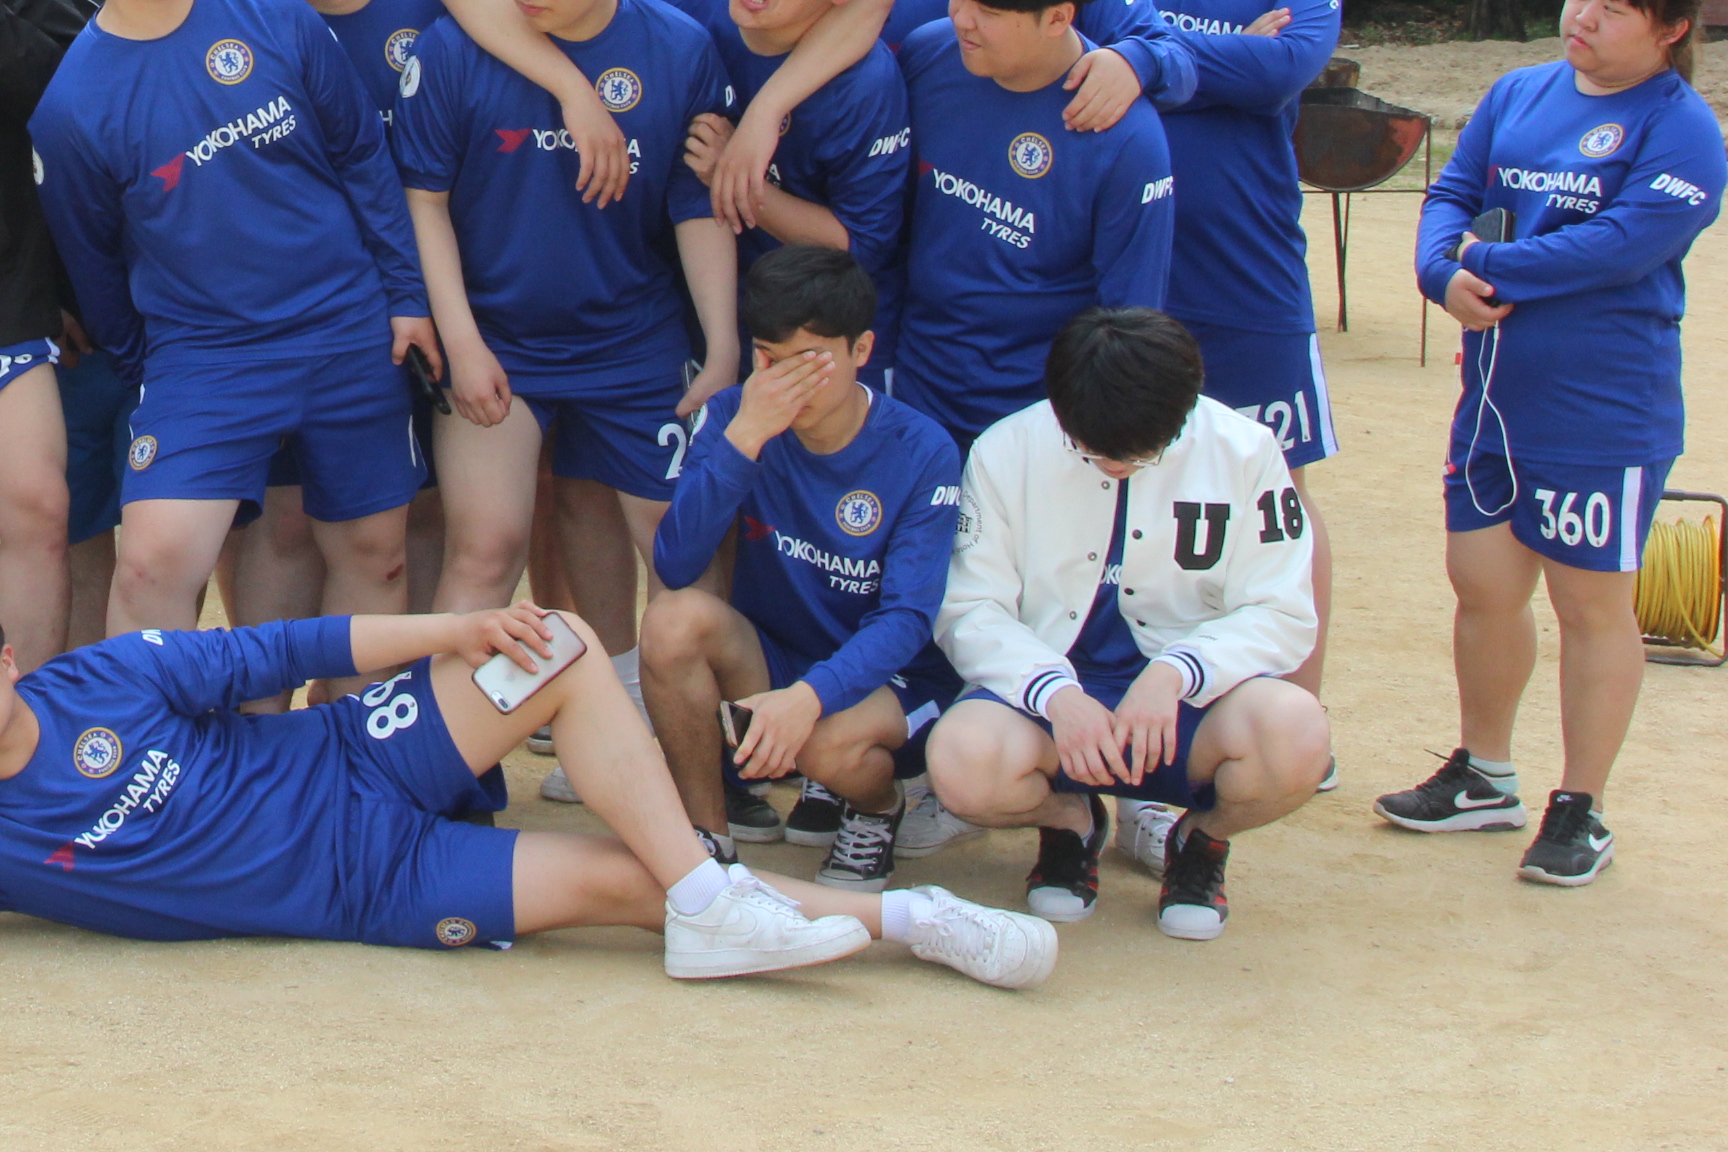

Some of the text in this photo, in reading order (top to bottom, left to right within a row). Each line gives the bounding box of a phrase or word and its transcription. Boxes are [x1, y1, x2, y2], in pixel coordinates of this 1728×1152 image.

[210, 42, 239, 60] CHELSEA
[604, 71, 634, 83] CHELSEA
[185, 95, 292, 166] YOKOHAMA
[251, 114, 296, 149] TYRES
[1020, 136, 1048, 155] CHELSEA
[1497, 167, 1602, 197] YOKOHAMA
[1649, 173, 1707, 206] DWFC
[932, 167, 1035, 234] YOKOHAMA
[1545, 193, 1600, 214] TYRES
[980, 217, 1032, 249] TYRES
[845, 493, 875, 506] CHELSEA
[1256, 486, 1304, 545] 18
[1534, 488, 1611, 548] 360
[1173, 501, 1231, 571] U
[774, 529, 881, 578] YOKOHAMA
[829, 575, 880, 595] TYRES
[77, 732, 97, 761] CHELSEA
[74, 749, 169, 850] YOKOHAMA
[143, 759, 181, 813] TYRES
